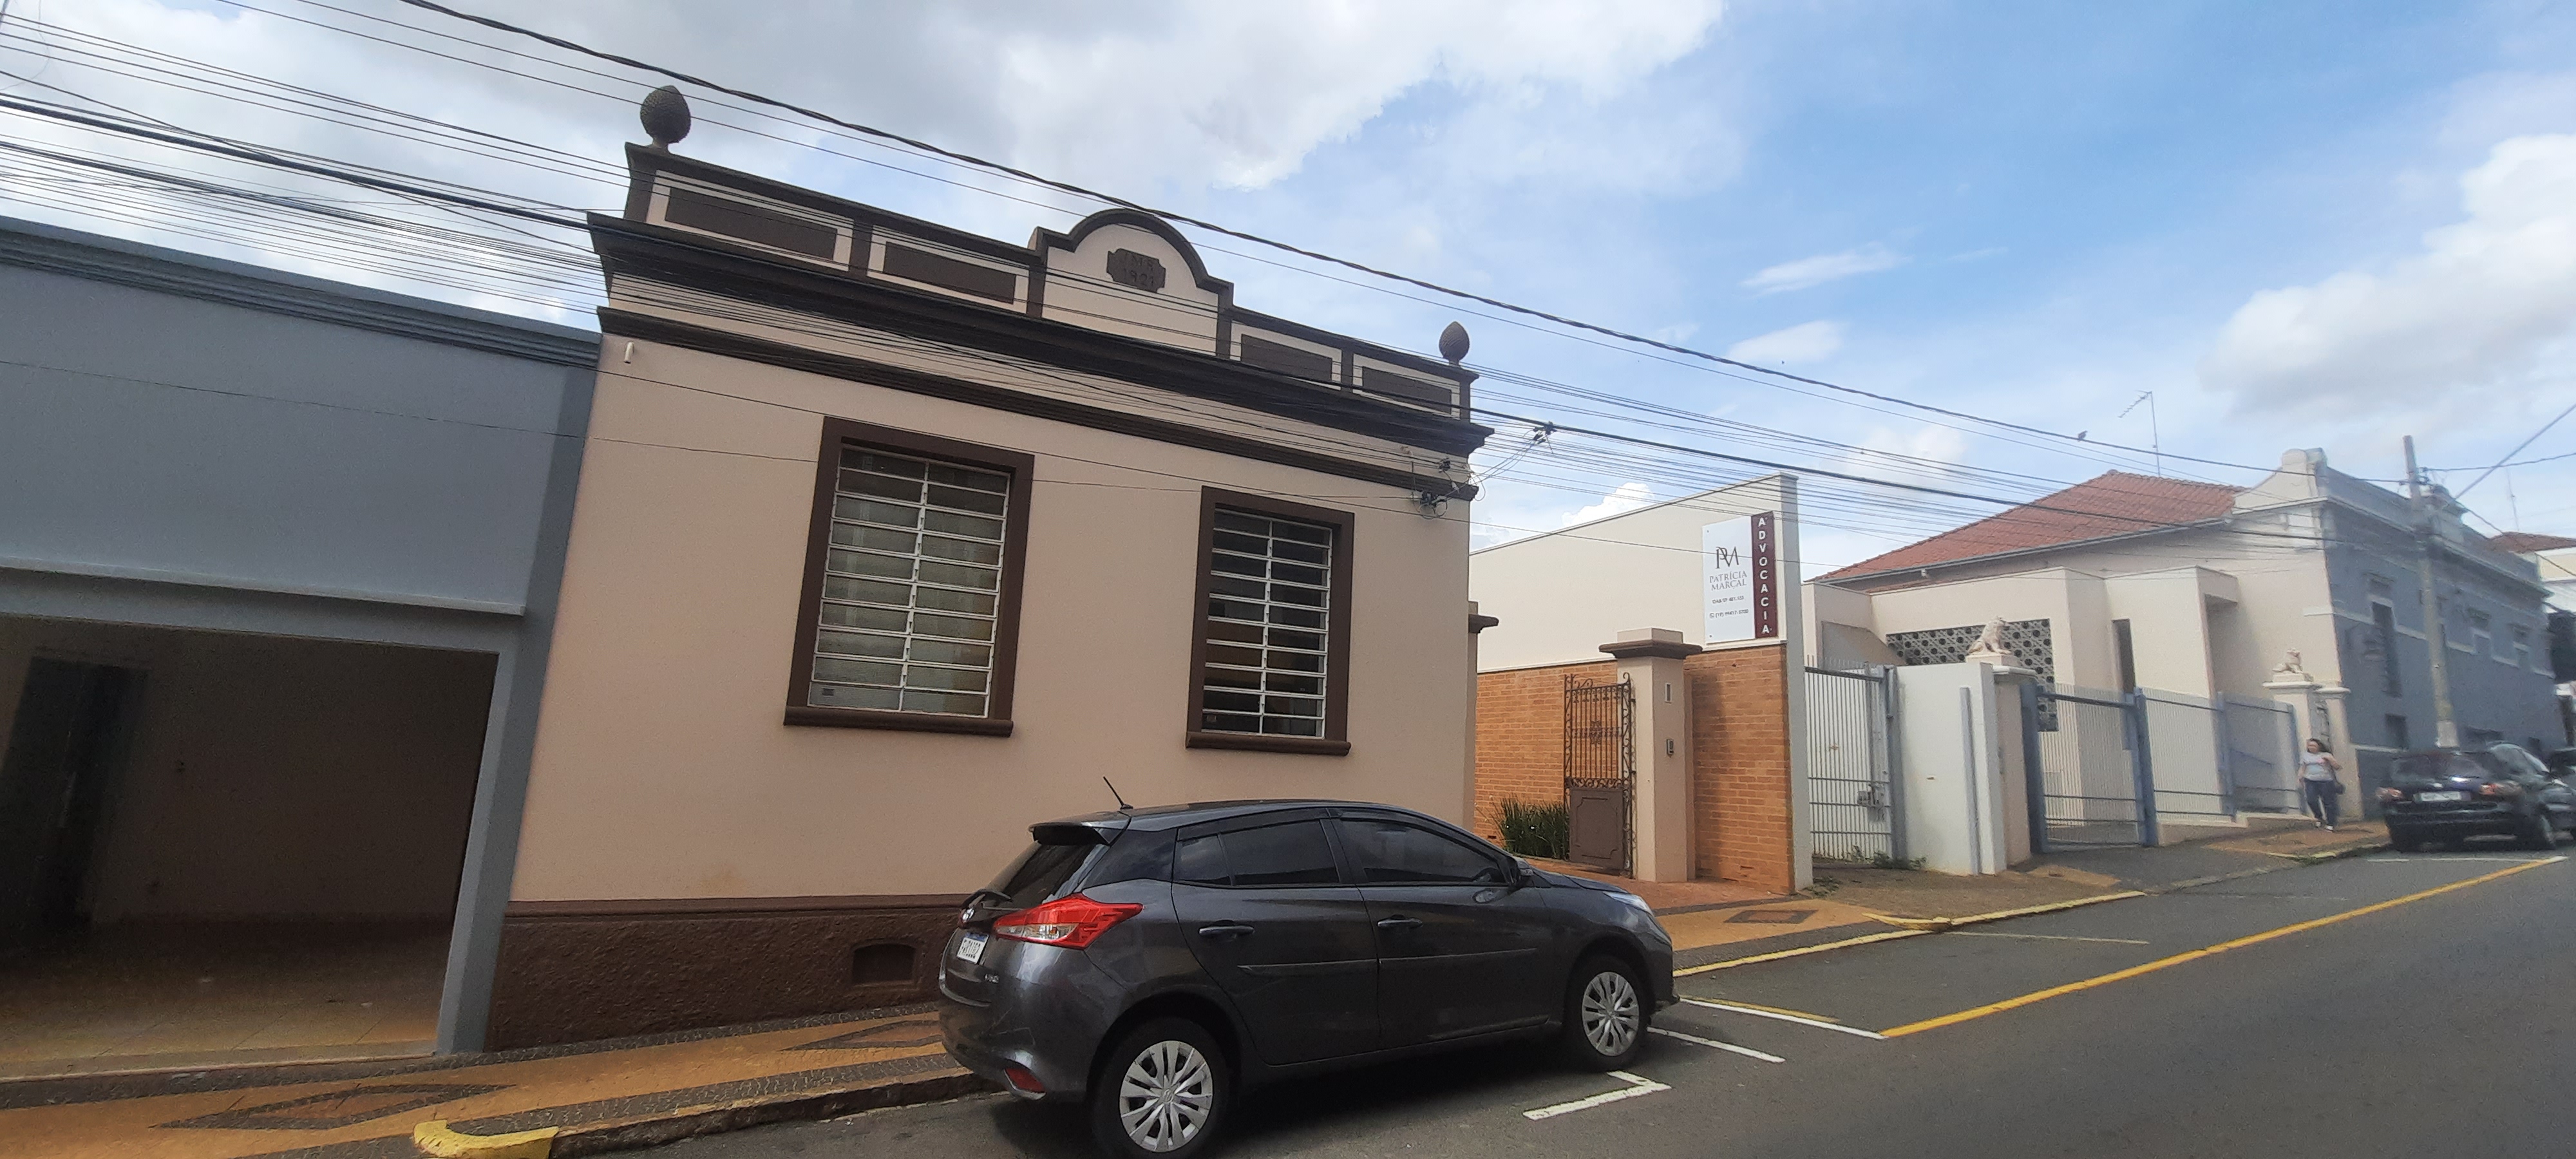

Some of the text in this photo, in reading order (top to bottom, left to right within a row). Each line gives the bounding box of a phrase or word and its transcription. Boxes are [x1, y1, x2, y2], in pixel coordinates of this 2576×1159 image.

[1710, 570, 1747, 583] PATRÍCIA
[1758, 517, 1770, 634] ADVOCACIA
[1711, 580, 1747, 590] MARÇAL
